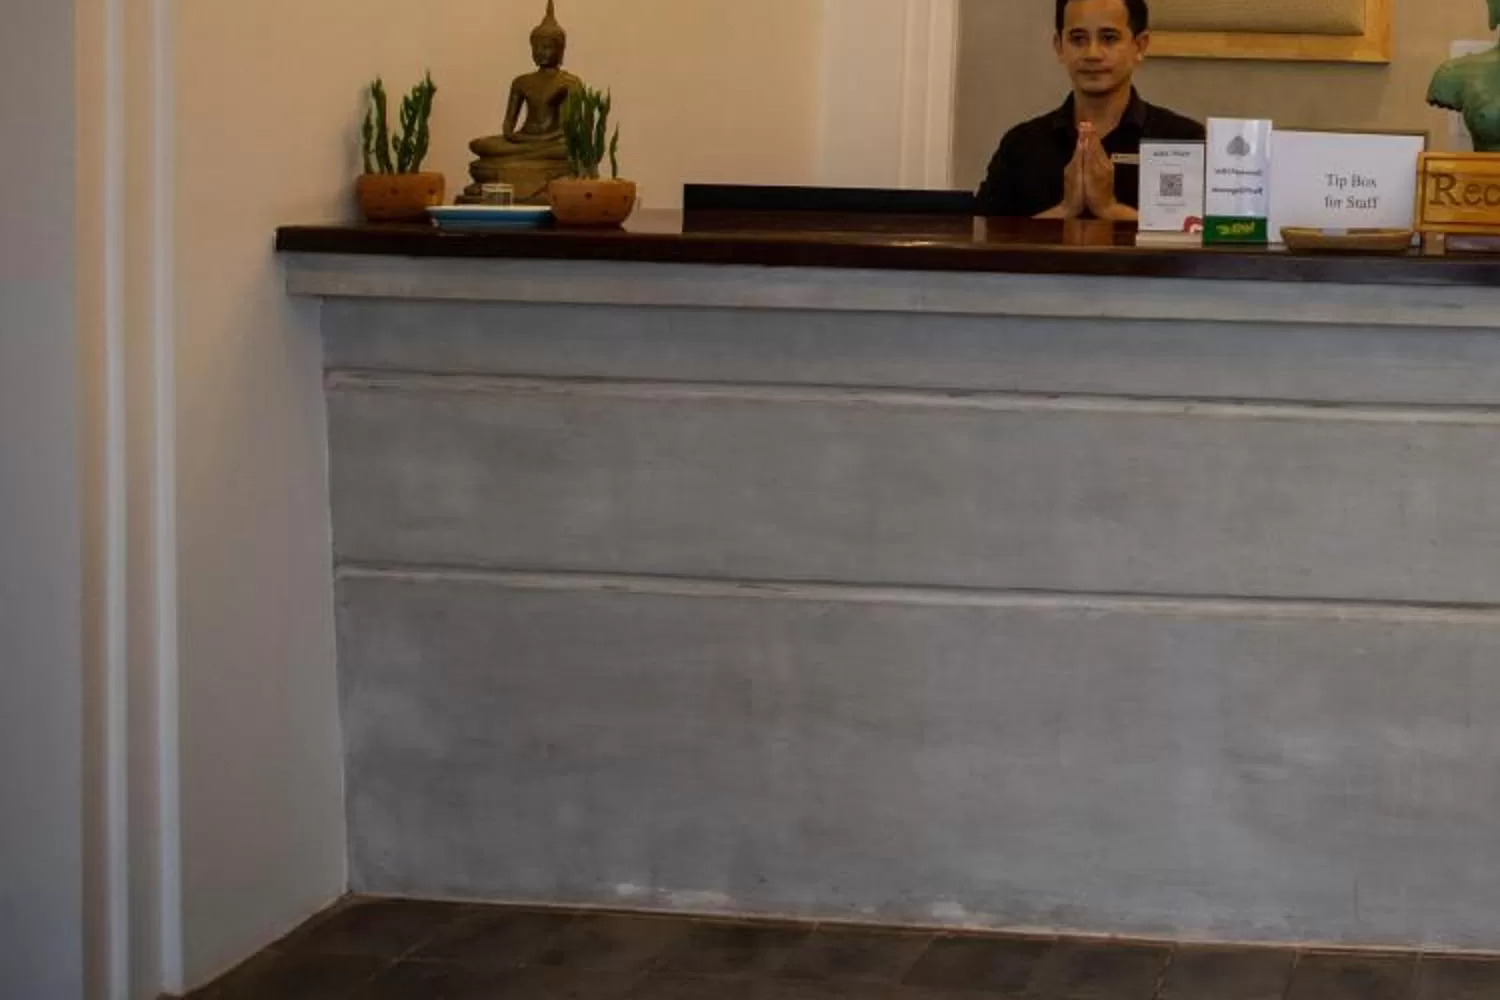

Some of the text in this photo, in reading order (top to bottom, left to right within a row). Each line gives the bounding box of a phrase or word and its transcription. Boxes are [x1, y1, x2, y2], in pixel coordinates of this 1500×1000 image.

[1325, 173, 1377, 190] Tip Box
[1324, 195, 1379, 209] for Staff
